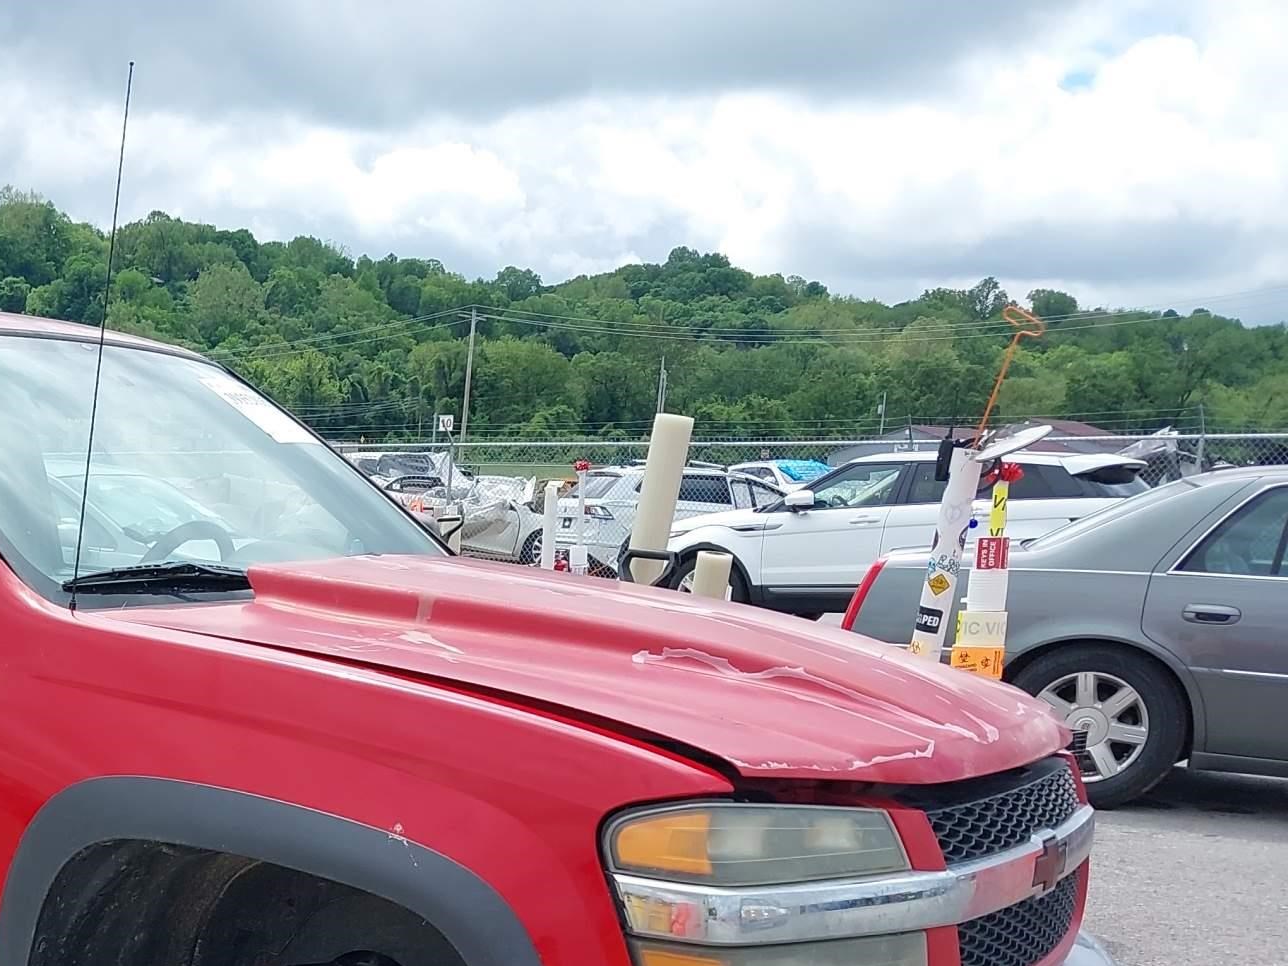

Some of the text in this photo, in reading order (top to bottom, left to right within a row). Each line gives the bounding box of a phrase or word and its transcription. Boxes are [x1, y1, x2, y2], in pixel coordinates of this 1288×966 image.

[980, 539, 989, 568] KEYS IN
[988, 541, 996, 567] OFFICE
